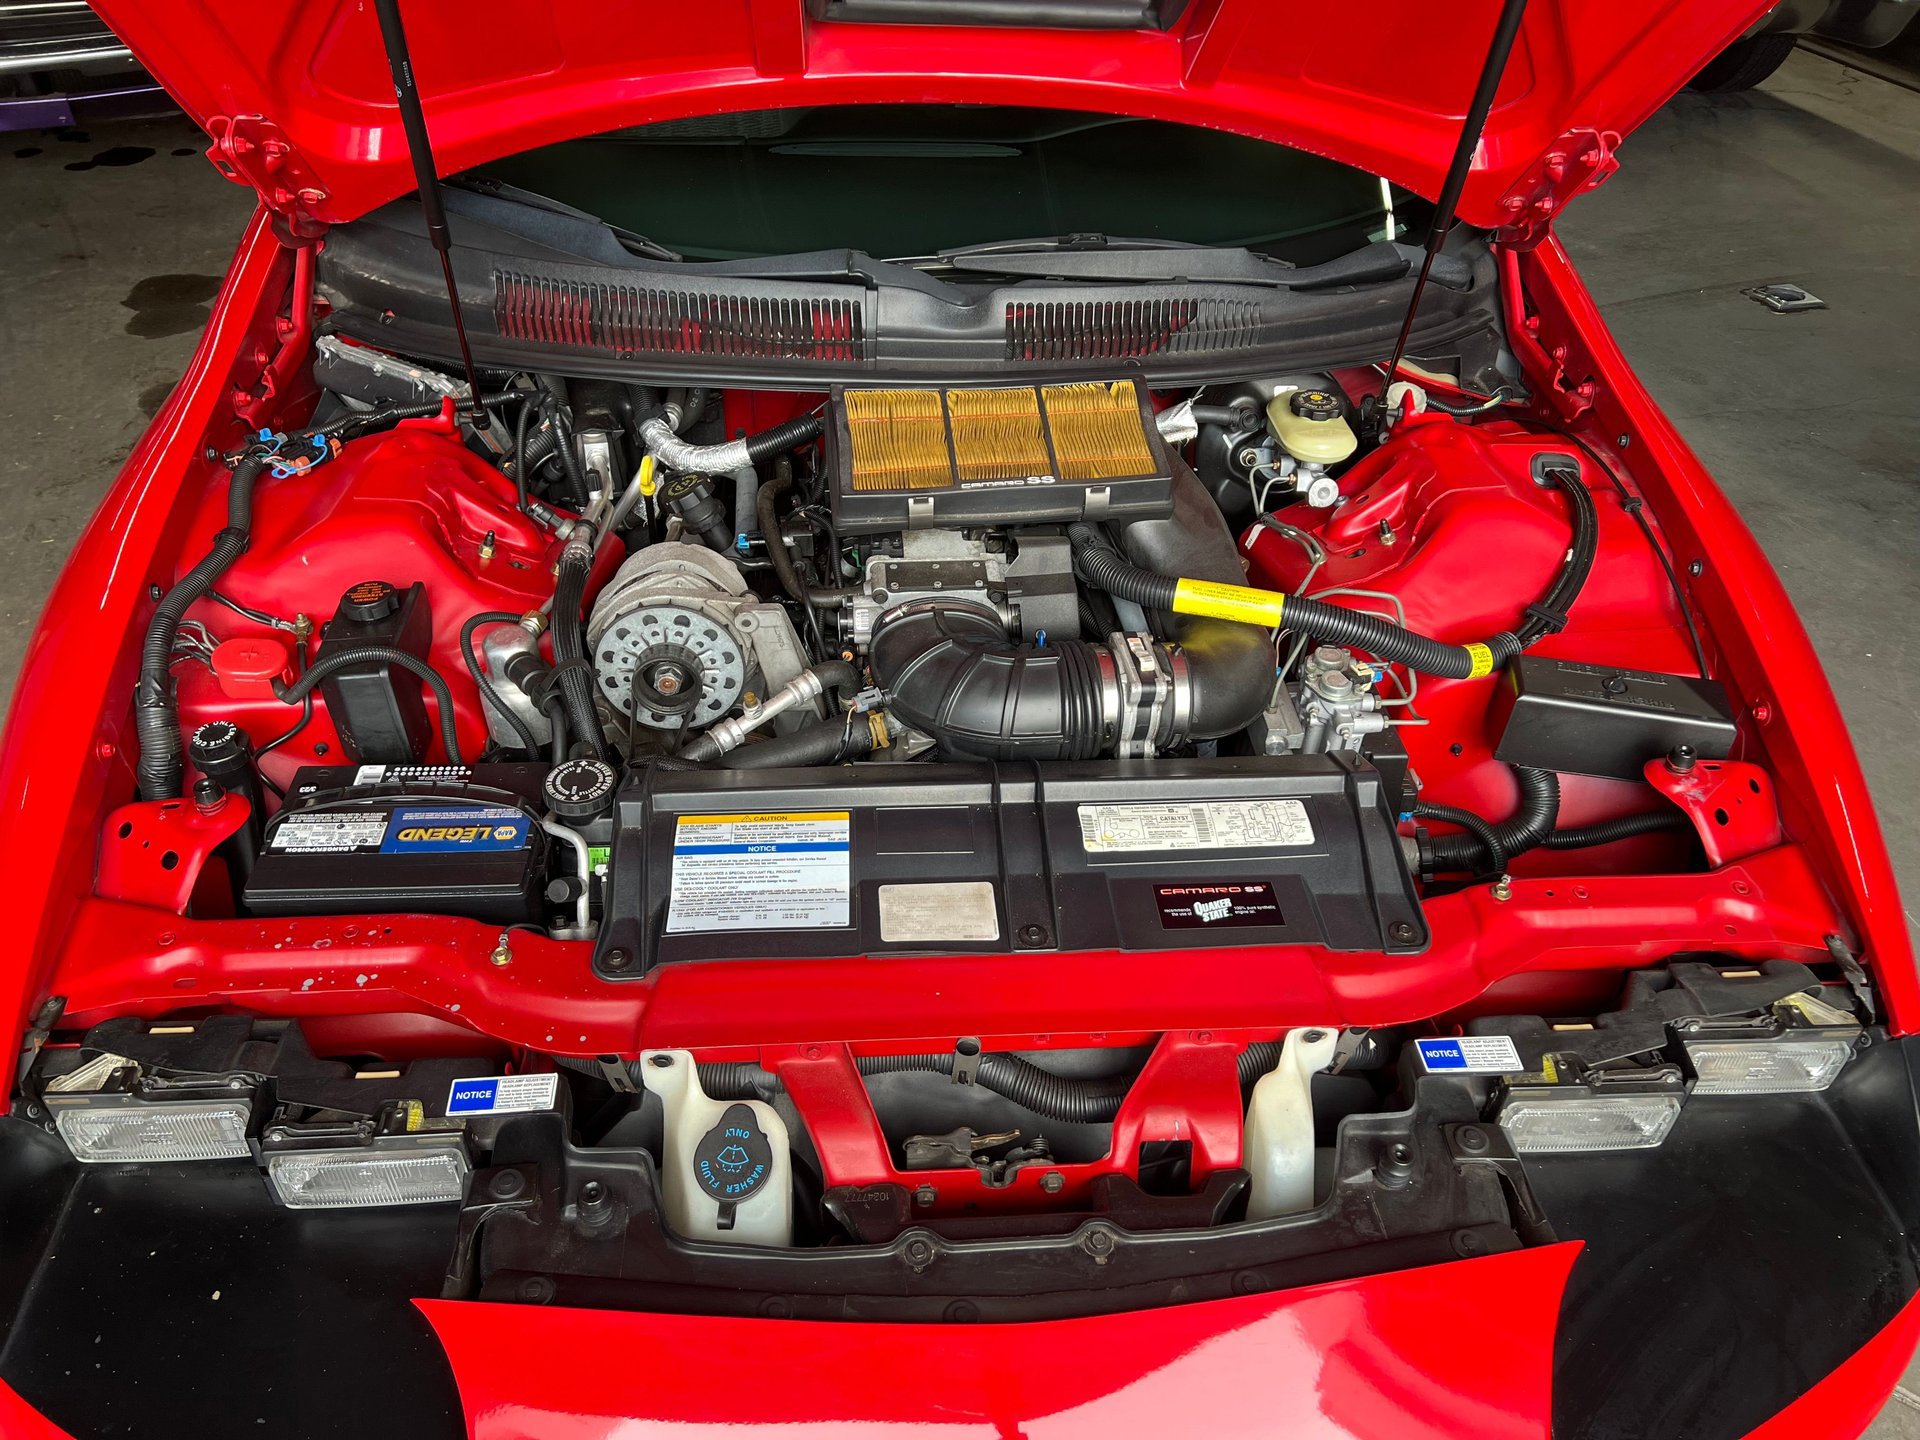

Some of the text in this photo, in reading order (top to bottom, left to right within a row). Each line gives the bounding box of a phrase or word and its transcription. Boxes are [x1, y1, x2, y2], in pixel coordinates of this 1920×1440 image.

[961, 476, 1055, 489] CAMARO SS
[192, 723, 210, 747] COOLANT
[210, 727, 237, 746] ENGINE
[588, 762, 612, 799] NEVER OPEN HOT
[579, 786, 597, 796] BOTTLE
[398, 826, 492, 841] LEGEND
[1160, 887, 1241, 895] CAMARO
[1193, 898, 1232, 916] QUAKER
[1202, 908, 1229, 922] STATE
[456, 1090, 492, 1100] NOTICE
[701, 1128, 764, 1193] WASHER FLUID ONLY
